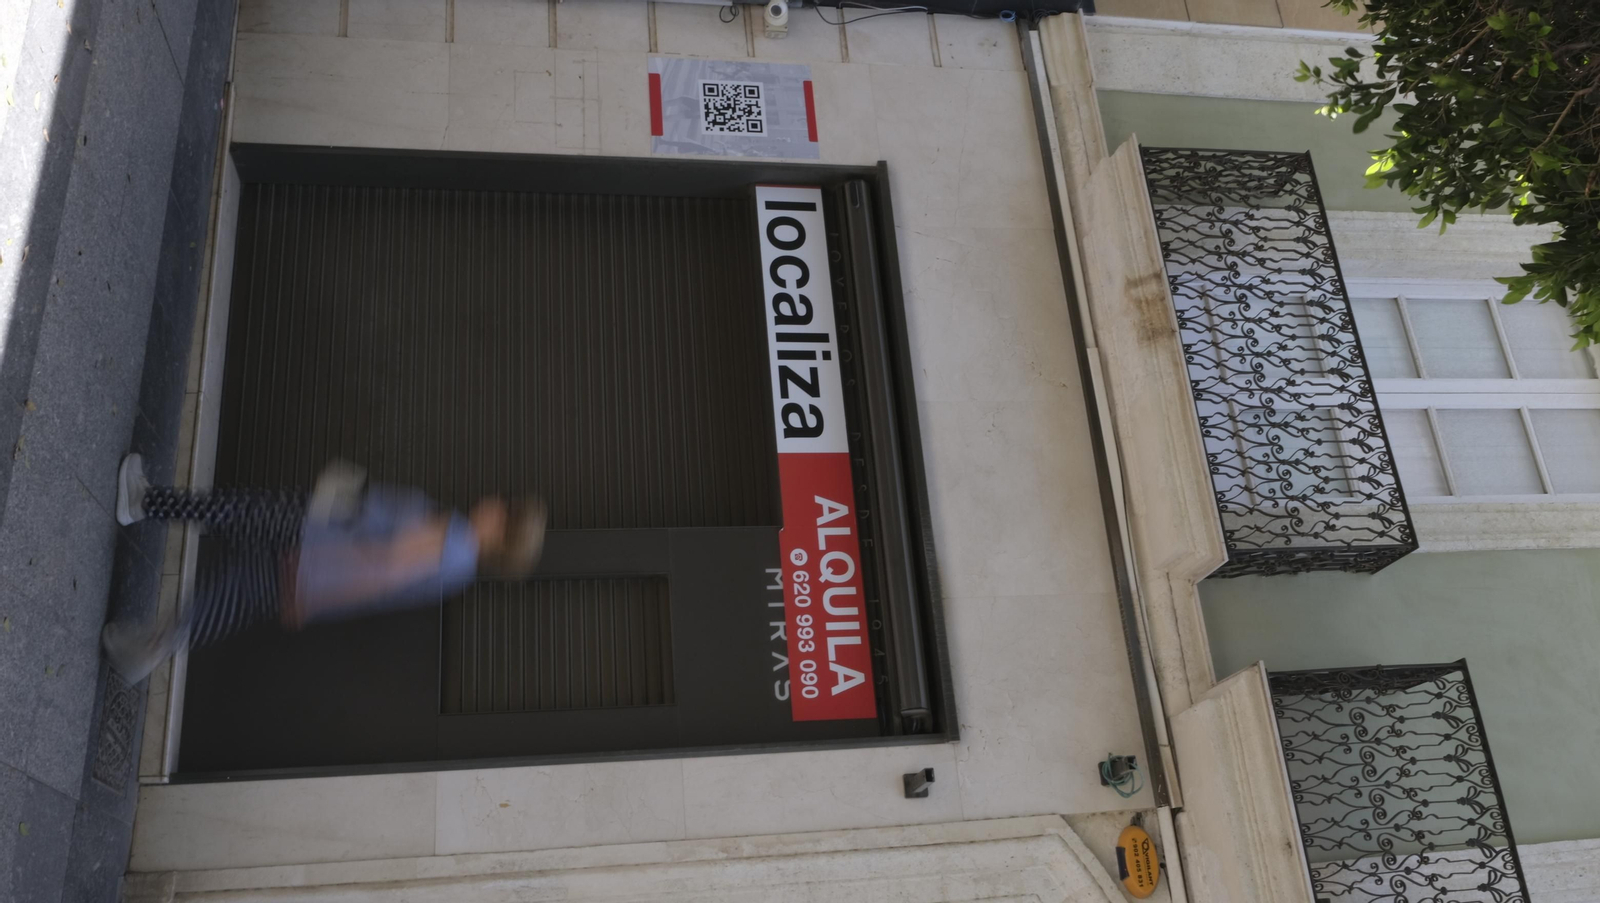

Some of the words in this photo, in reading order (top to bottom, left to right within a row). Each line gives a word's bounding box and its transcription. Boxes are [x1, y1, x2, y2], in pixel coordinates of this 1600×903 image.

[765, 200, 832, 440] localiza
[793, 570, 812, 607] 620
[814, 495, 865, 696] ALQUILA
[796, 614, 815, 653] 993
[799, 660, 819, 699] 090
[1145, 852, 1153, 886] VIGILANT
